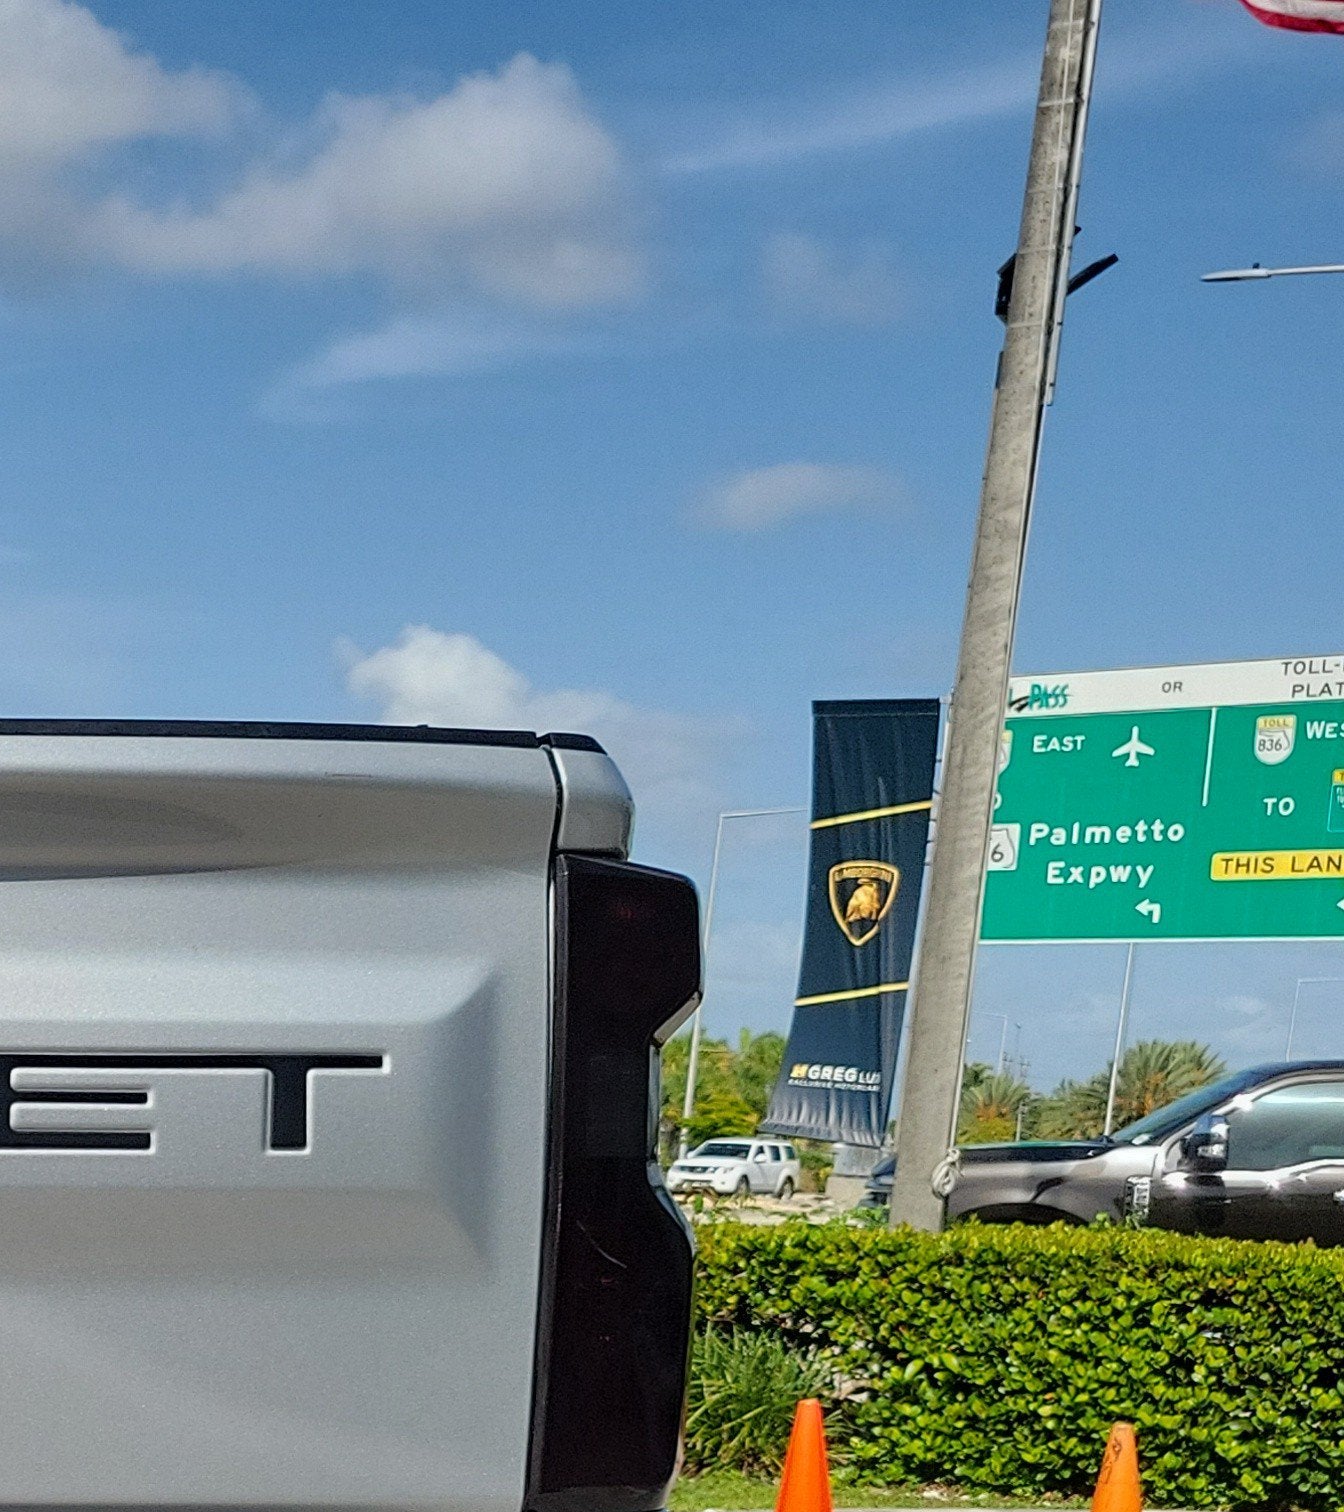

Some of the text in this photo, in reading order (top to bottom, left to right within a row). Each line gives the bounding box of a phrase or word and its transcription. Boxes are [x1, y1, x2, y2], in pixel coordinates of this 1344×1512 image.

[1281, 659, 1344, 676] TOLL-
[1161, 681, 1183, 693] OR
[1263, 718, 1290, 728] TOLL
[1032, 735, 1086, 753] EAST
[1257, 738, 1283, 752] 836
[1263, 797, 1296, 817] TO
[1029, 819, 1186, 846] Palmetto
[1221, 856, 1275, 875] THIS
[1046, 861, 1154, 889] Expwy
